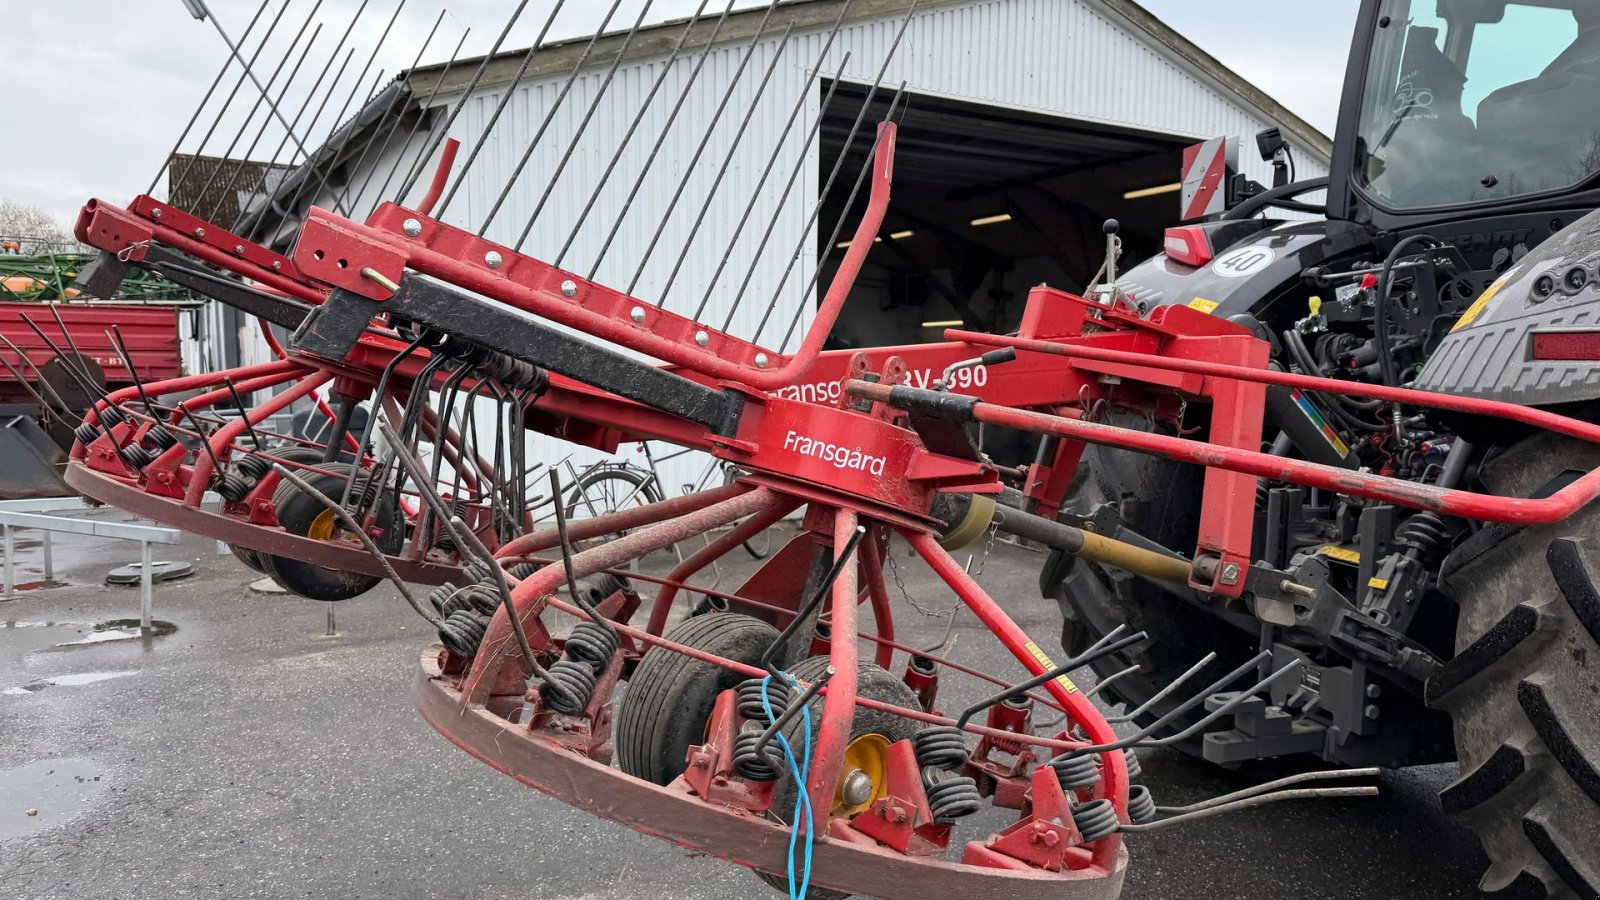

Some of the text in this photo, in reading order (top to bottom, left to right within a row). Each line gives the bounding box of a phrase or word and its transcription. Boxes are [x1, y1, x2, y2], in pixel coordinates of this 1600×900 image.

[1222, 250, 1266, 272] 40
[763, 380, 842, 404] ransg
[783, 430, 887, 477] Fransgård
